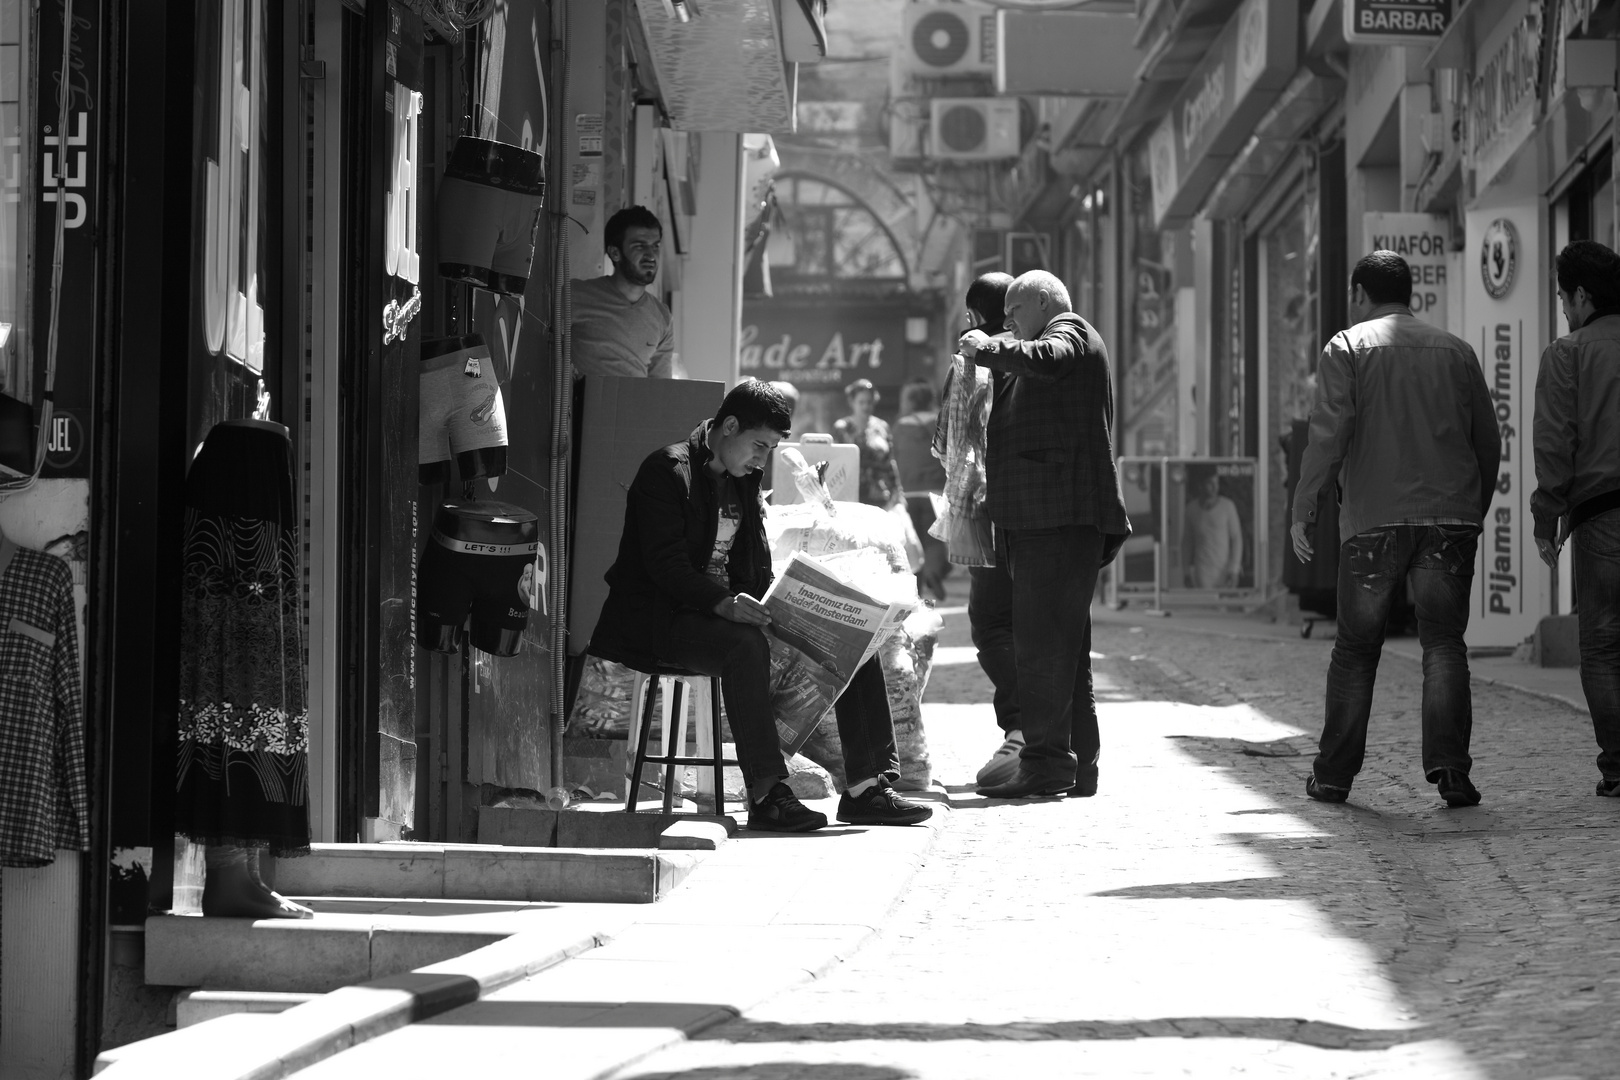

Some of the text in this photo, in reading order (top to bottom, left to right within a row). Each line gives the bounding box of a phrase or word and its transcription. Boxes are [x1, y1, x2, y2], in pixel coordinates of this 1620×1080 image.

[1360, 9, 1445, 31] BARBAR
[816, 331, 885, 369] Art
[48, 417, 72, 452] JEL
[1495, 472, 1511, 495] &
[464, 543, 497, 553] LET'S
[1488, 507, 1517, 616] Pijama
[784, 591, 869, 628] hedef Amsterdam!
[842, 602, 862, 615] tam
